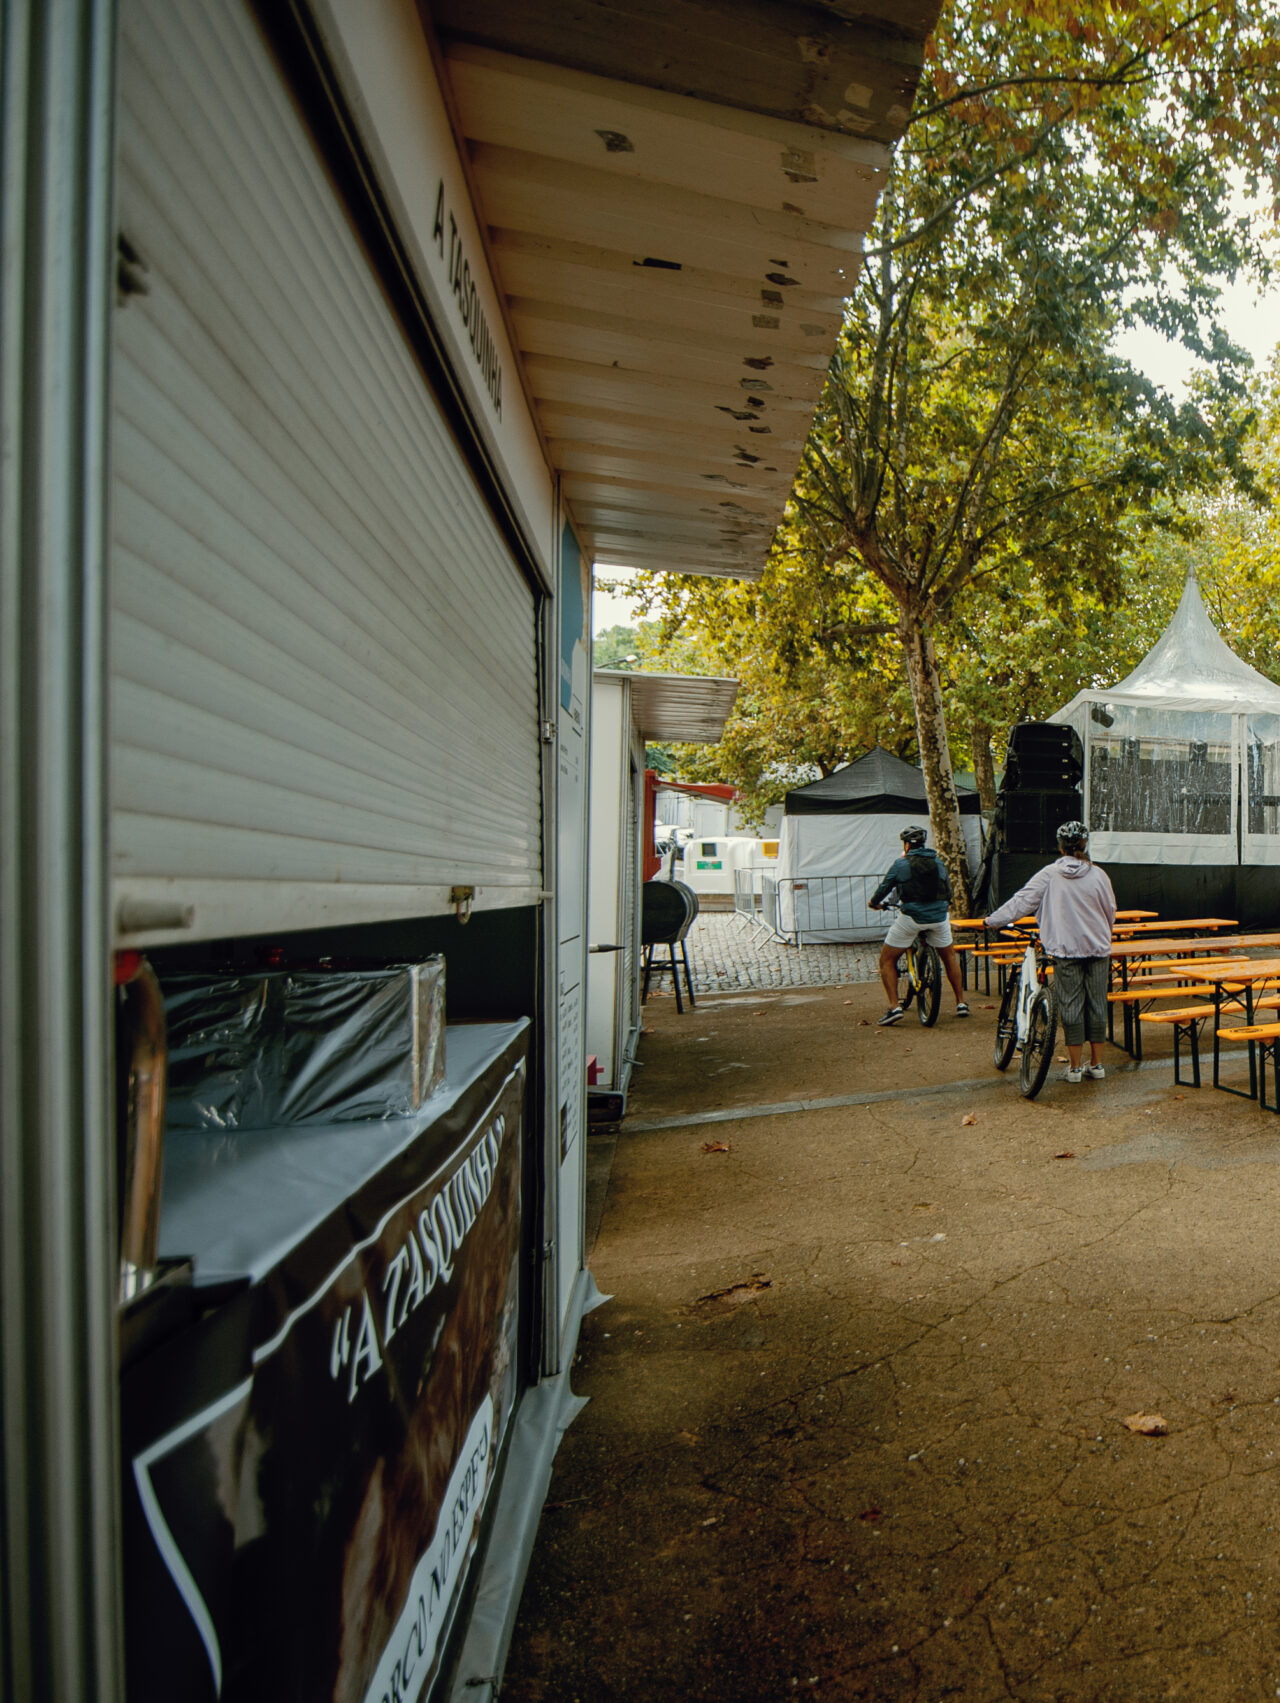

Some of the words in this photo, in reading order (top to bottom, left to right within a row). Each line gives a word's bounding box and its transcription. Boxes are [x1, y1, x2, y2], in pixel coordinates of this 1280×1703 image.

[433, 177, 444, 260] A
[449, 208, 502, 424] TASQUINHA
[429, 1528, 451, 1622] NO
